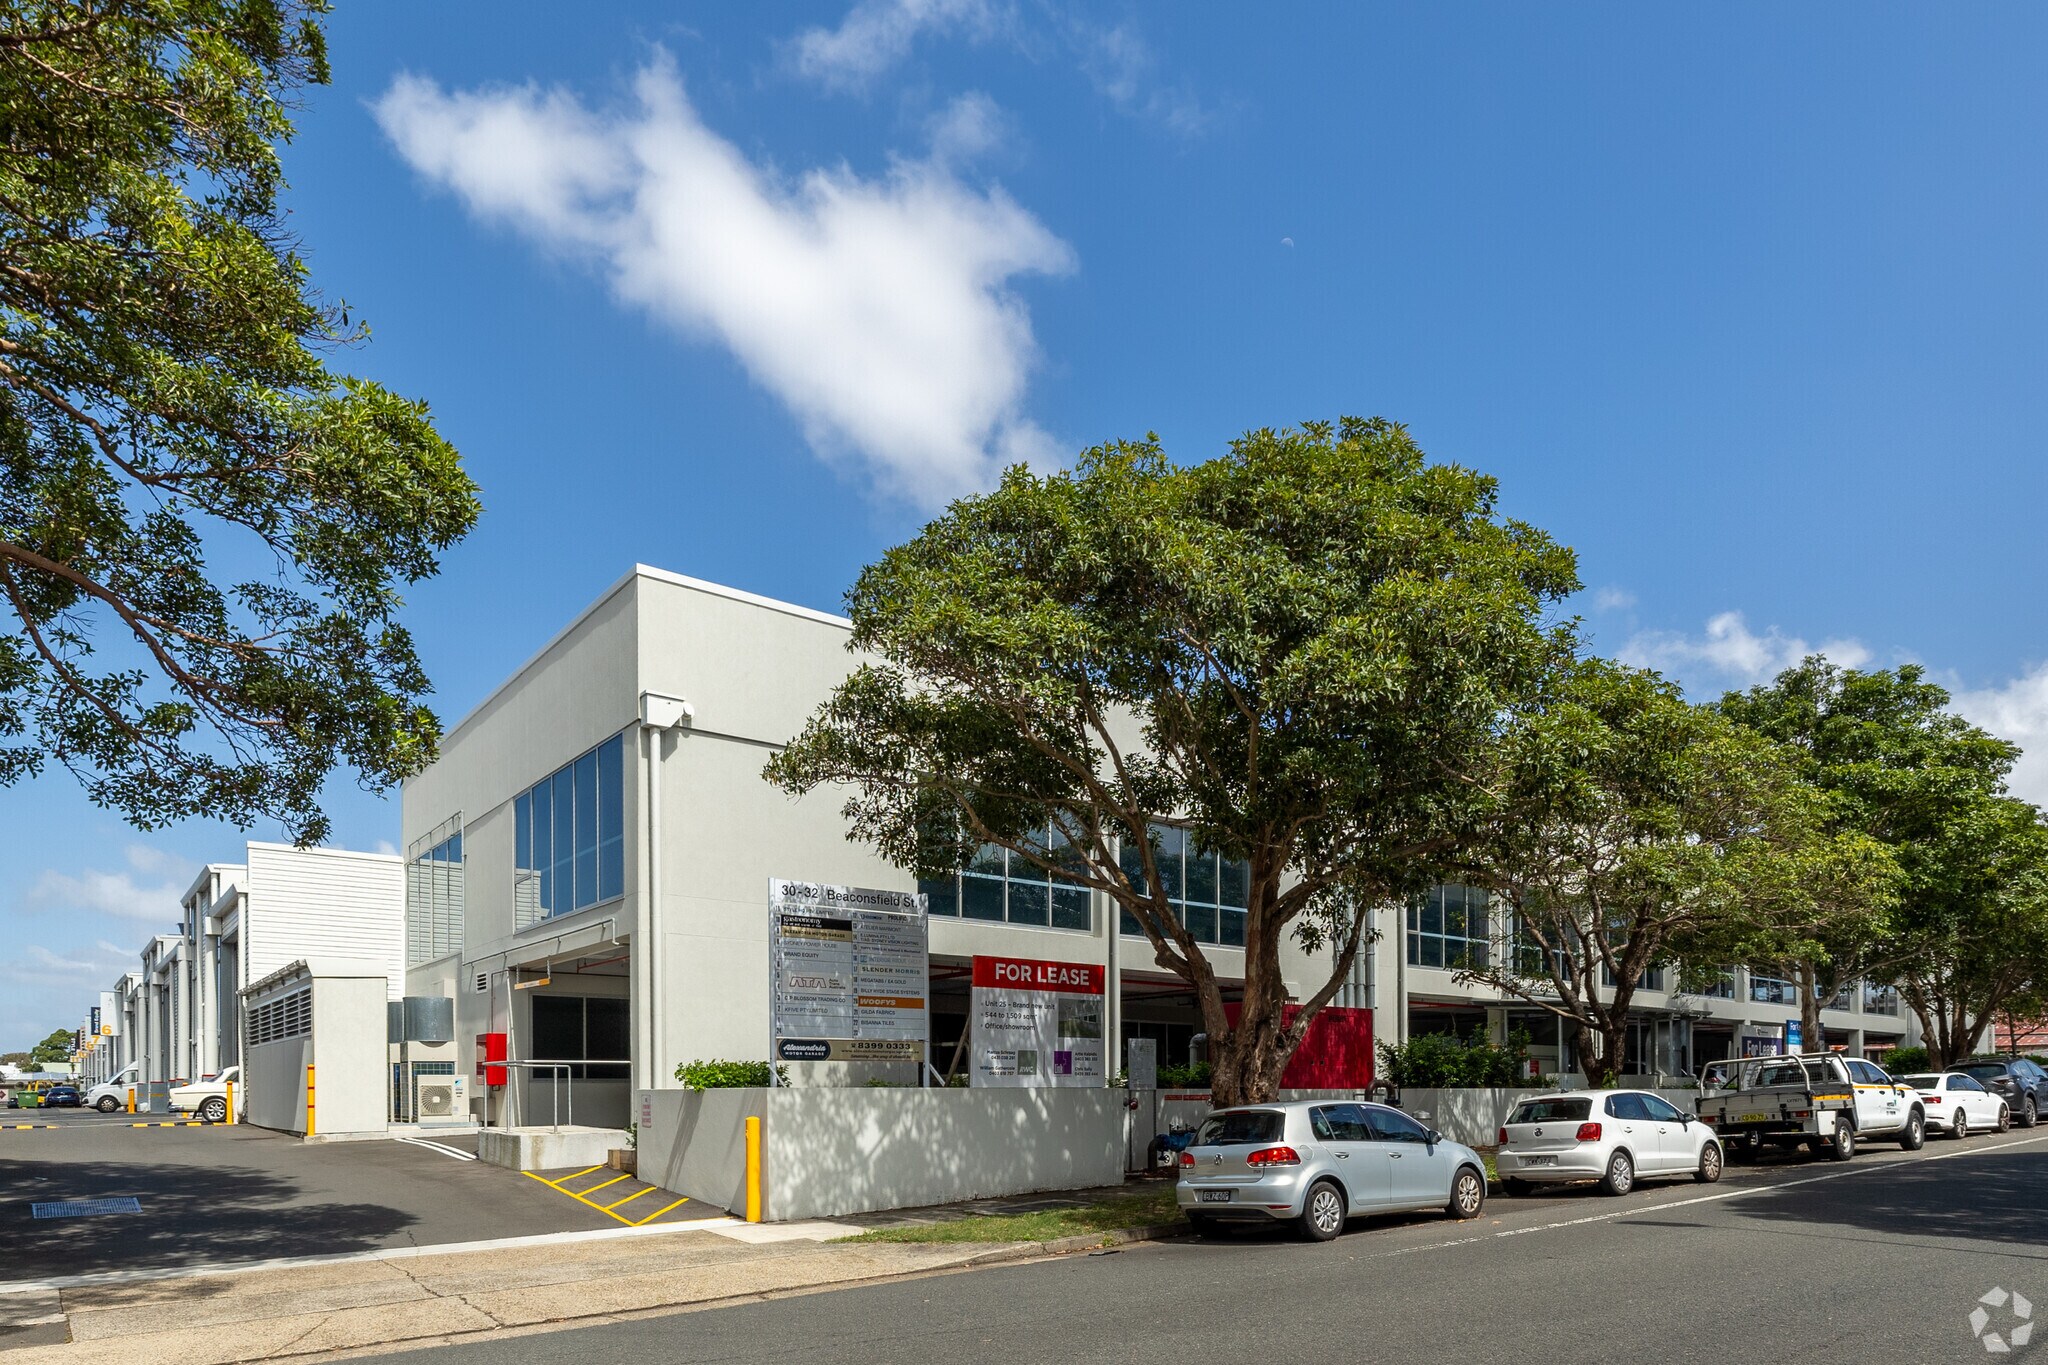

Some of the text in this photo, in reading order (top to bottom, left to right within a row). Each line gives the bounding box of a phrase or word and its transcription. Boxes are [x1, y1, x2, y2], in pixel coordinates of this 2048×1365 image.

[827, 889, 900, 906] Beaconsfield
[903, 897, 917, 908] St.
[995, 962, 1089, 986] FOR LEASE
[860, 998, 896, 1006] WOOFYS
[102, 1024, 112, 1035] 6
[91, 1035, 101, 1044] 7
[783, 1044, 826, 1052] Alexandria
[1747, 1040, 1777, 1056] For Lease
